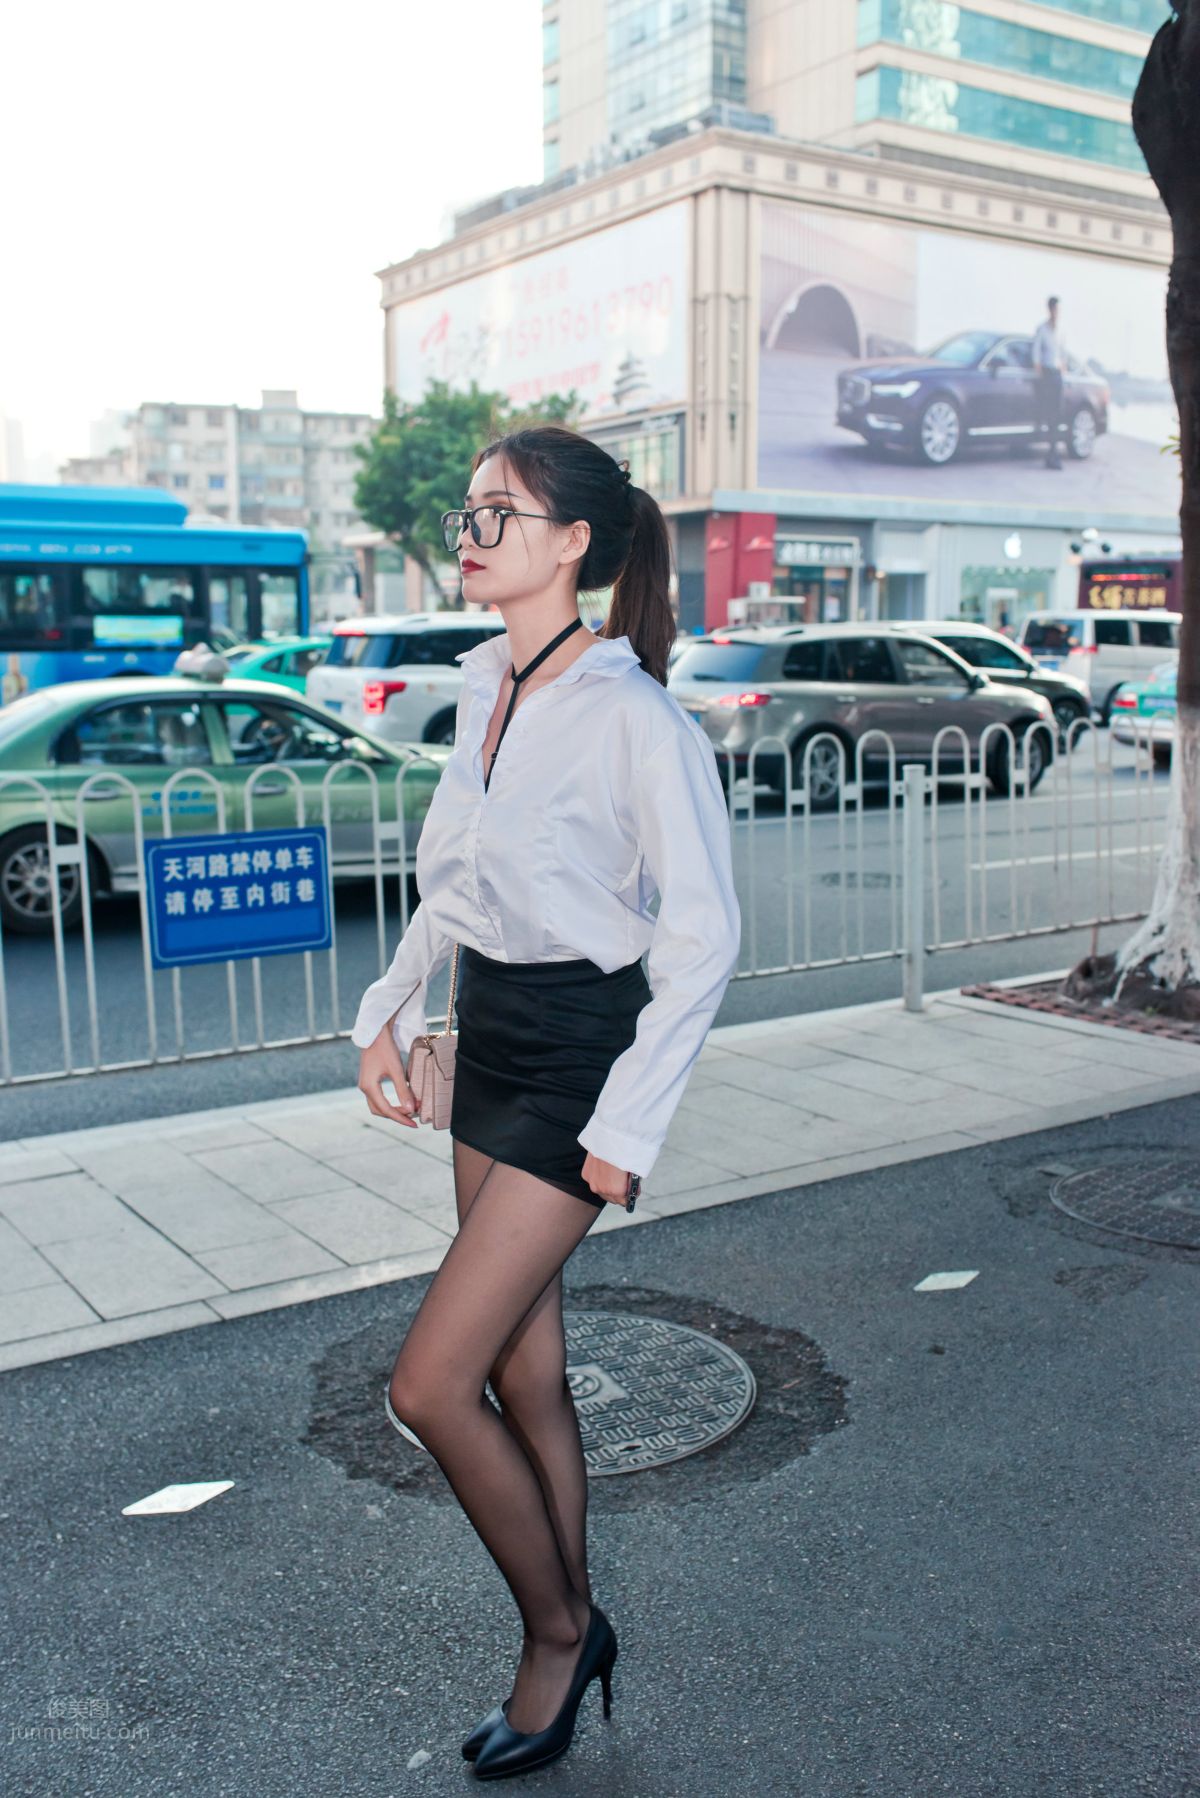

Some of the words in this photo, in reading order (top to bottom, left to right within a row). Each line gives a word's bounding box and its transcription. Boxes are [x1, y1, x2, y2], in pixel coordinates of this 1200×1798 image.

[163, 846, 314, 882] 天河路禁停单车
[165, 878, 315, 915] 请停至内街巷
